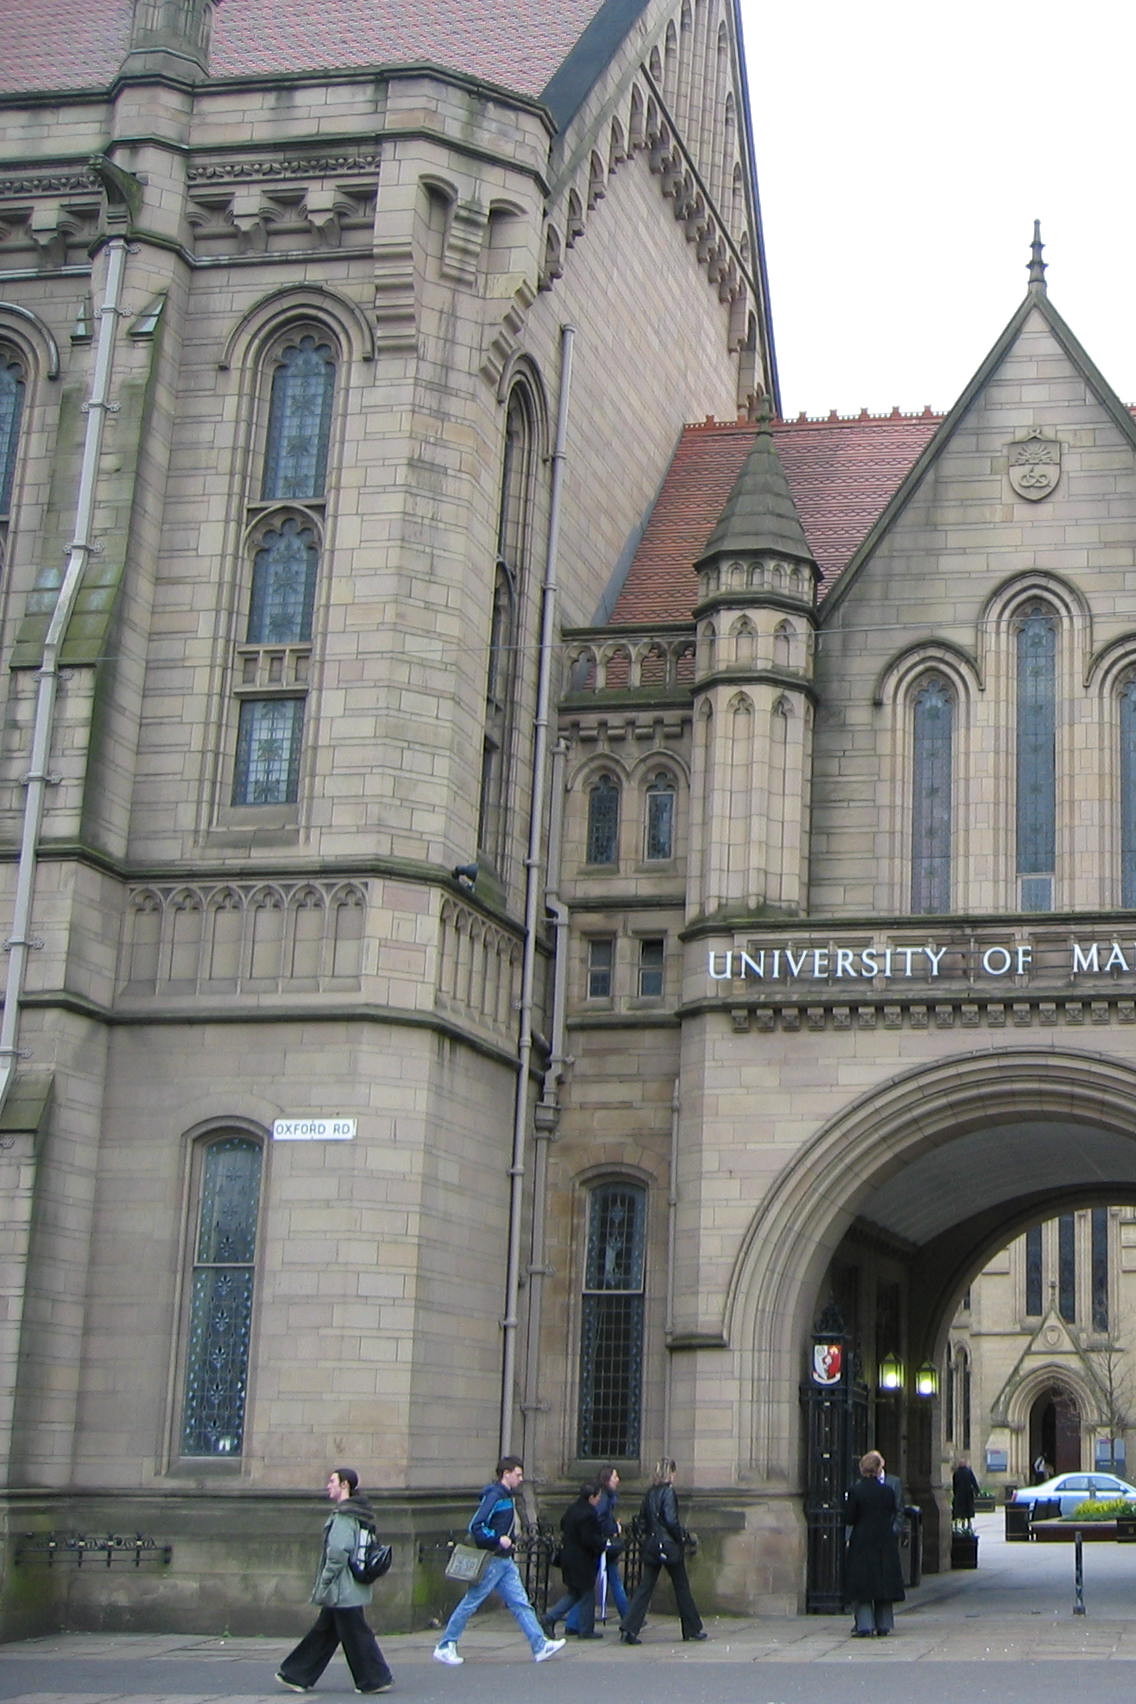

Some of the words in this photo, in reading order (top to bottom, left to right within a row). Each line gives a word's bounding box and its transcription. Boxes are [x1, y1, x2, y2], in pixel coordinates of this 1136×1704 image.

[708, 946, 948, 979] UNIVERSITY
[983, 945, 1032, 975] OF
[275, 1123, 326, 1135] OXFORD
[333, 1123, 351, 1134] RD
